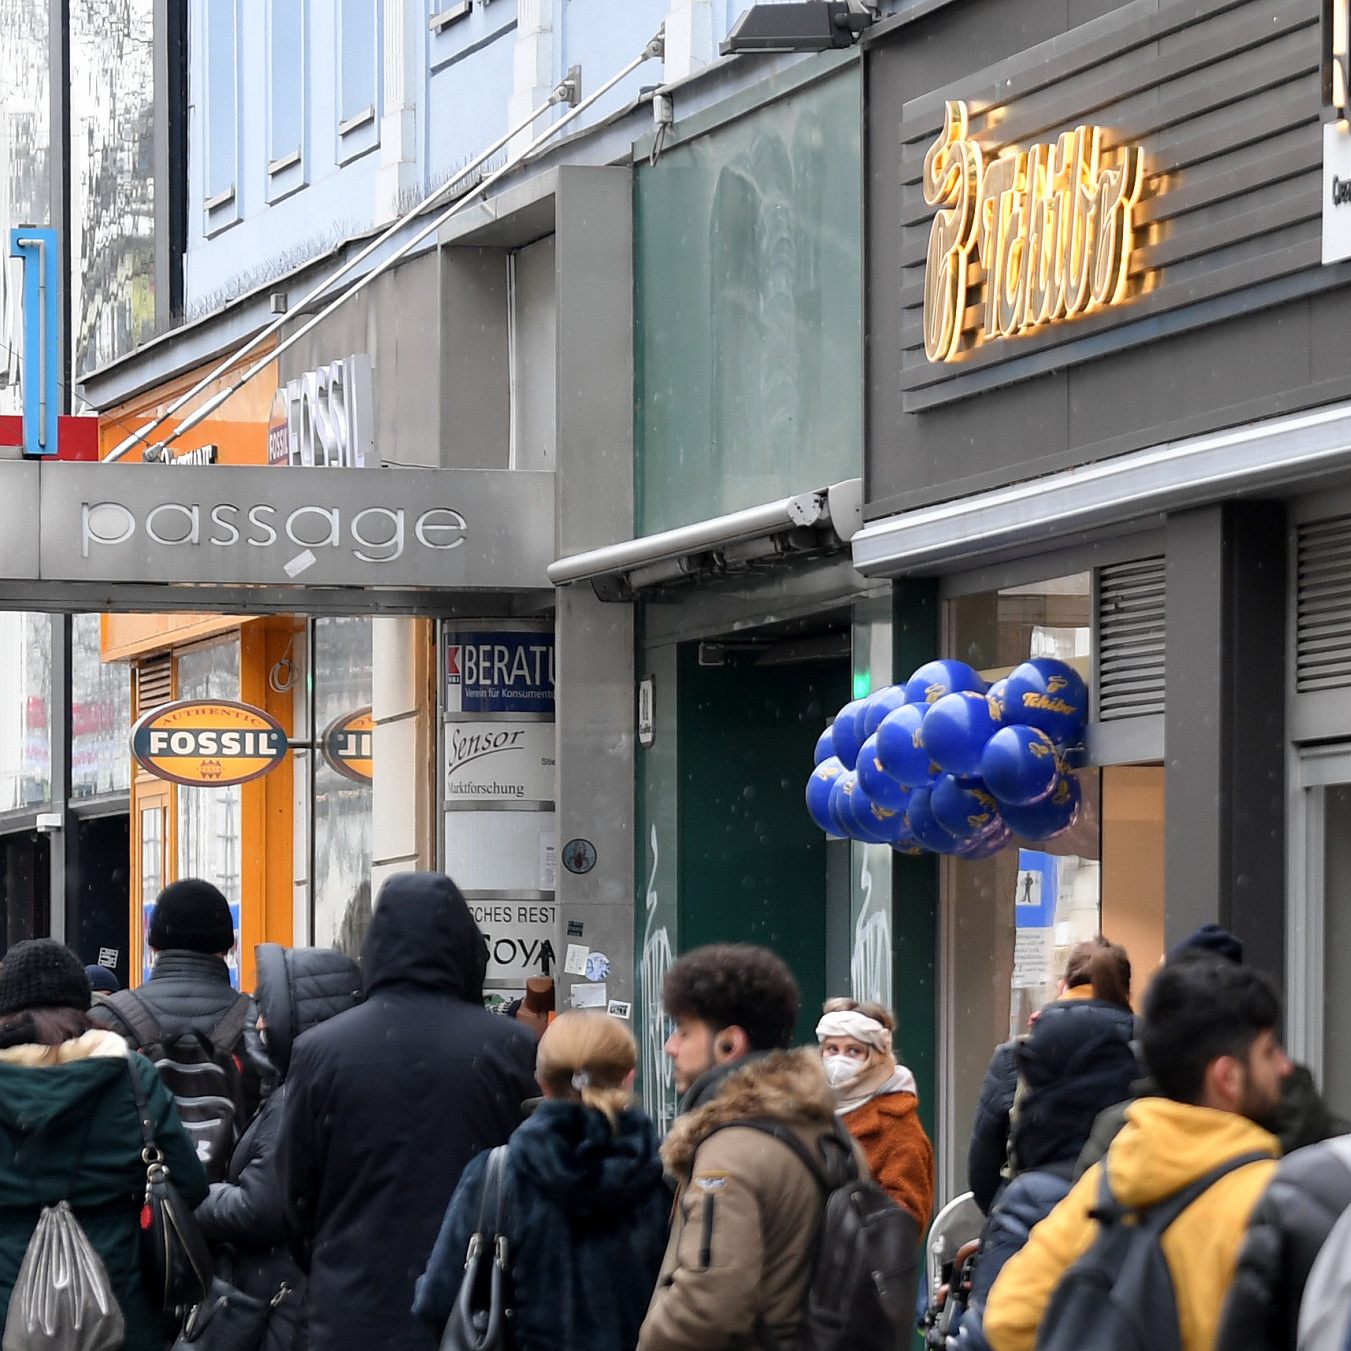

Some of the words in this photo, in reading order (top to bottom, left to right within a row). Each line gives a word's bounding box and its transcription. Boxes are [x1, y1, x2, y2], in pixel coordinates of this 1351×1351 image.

[81, 502, 467, 562] passage
[466, 688, 487, 698] Verein
[489, 688, 499, 698] für
[161, 707, 263, 727] AUTHENTIC
[149, 731, 278, 755] FOSSIL
[448, 728, 525, 767] Sensor
[448, 781, 525, 798] Marktforschung
